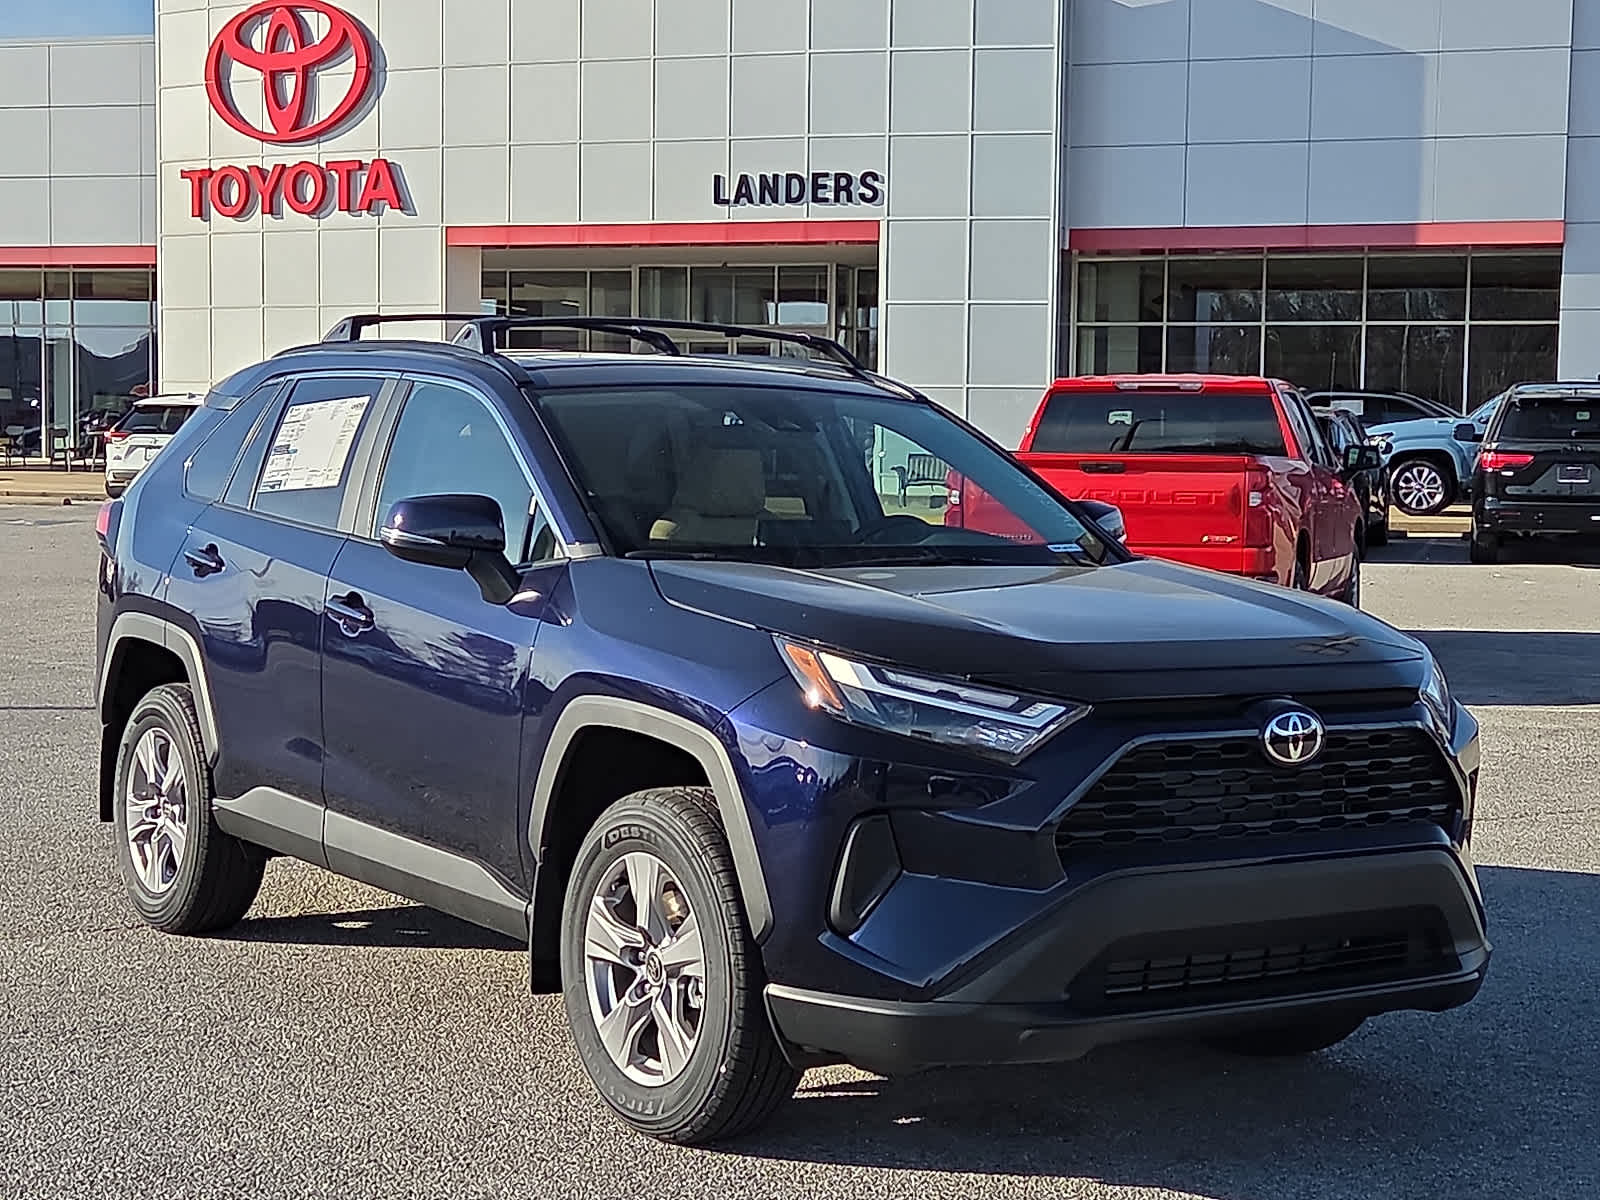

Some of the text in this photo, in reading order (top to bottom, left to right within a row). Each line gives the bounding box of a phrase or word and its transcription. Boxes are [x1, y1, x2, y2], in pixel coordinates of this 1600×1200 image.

[181, 158, 404, 218] TOYOTA
[713, 171, 882, 206] LANDERS
[1062, 487, 1225, 505] VROLET
